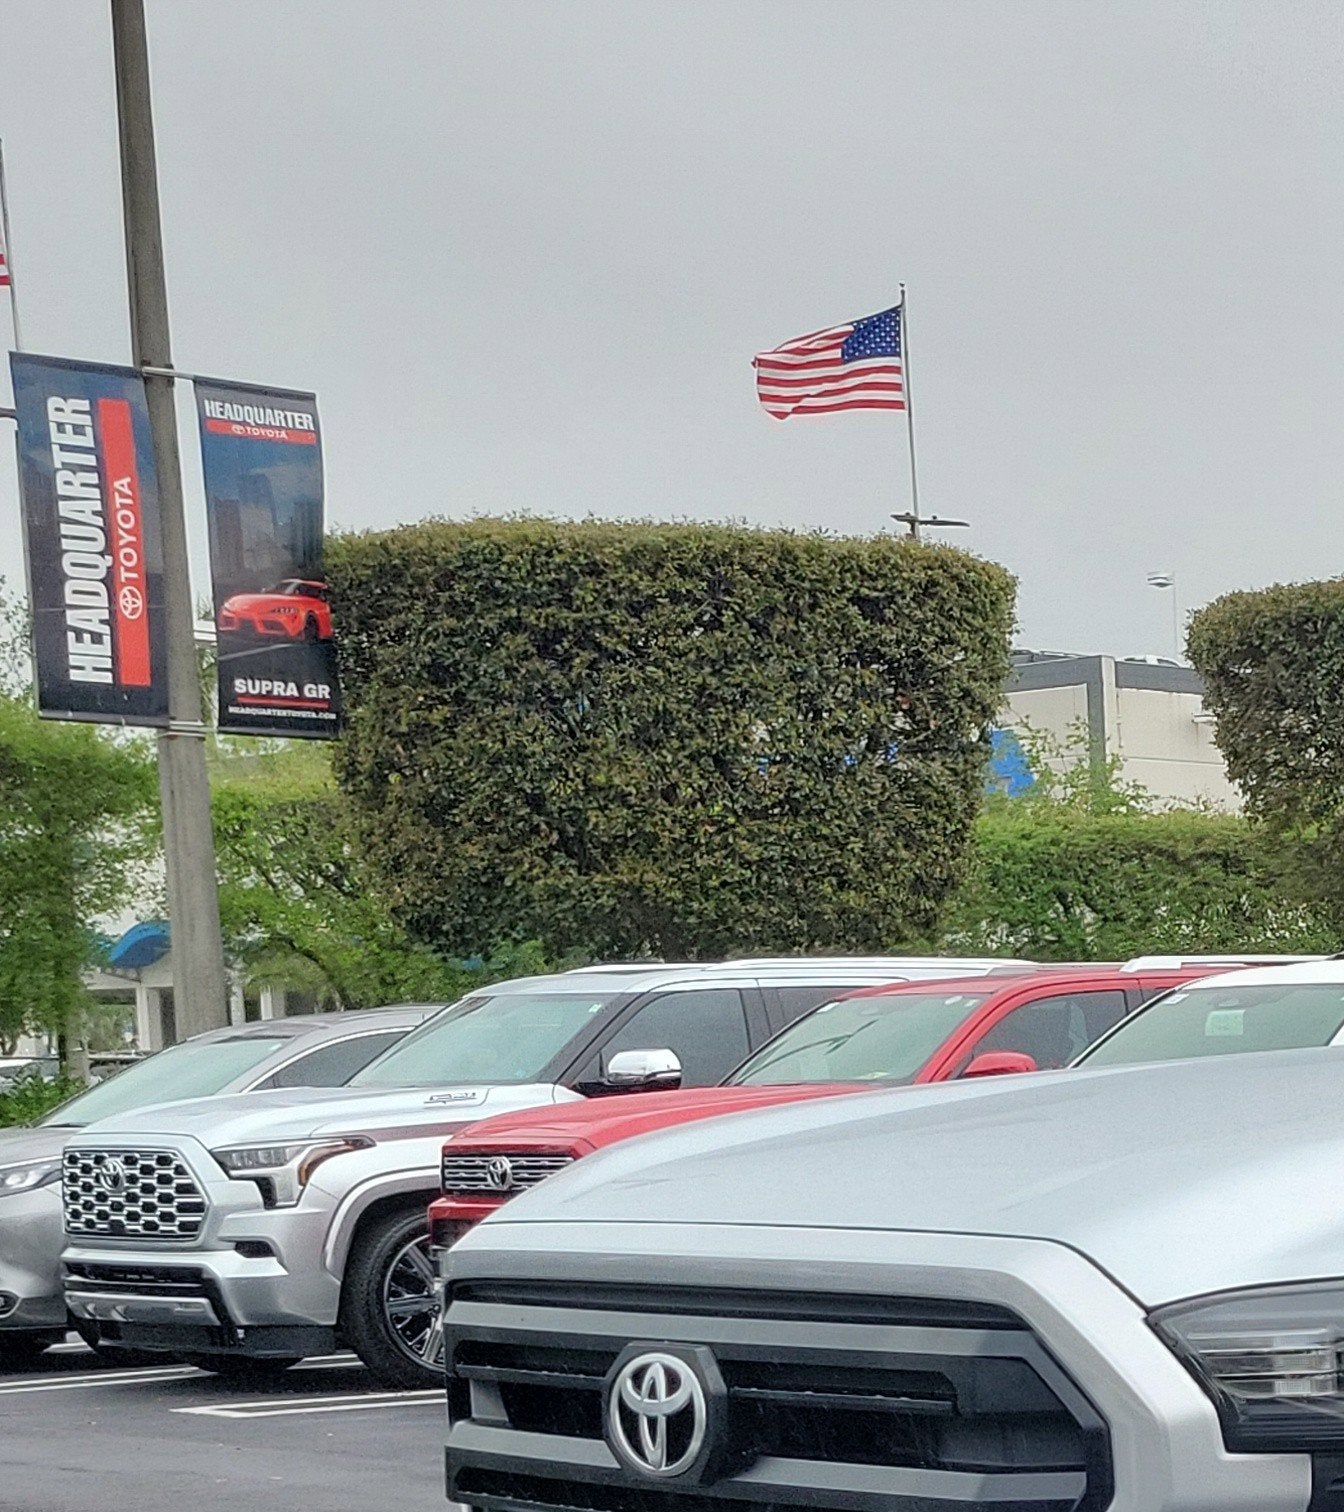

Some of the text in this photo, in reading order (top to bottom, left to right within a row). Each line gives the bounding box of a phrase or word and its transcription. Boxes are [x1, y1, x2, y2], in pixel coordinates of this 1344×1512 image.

[203, 399, 315, 431] HEADQUARTER
[246, 426, 288, 439] TOYOTA
[47, 396, 114, 684] HEADQUARTER
[113, 476, 138, 583] TOYOTA
[234, 678, 331, 699] SUPRA GR
